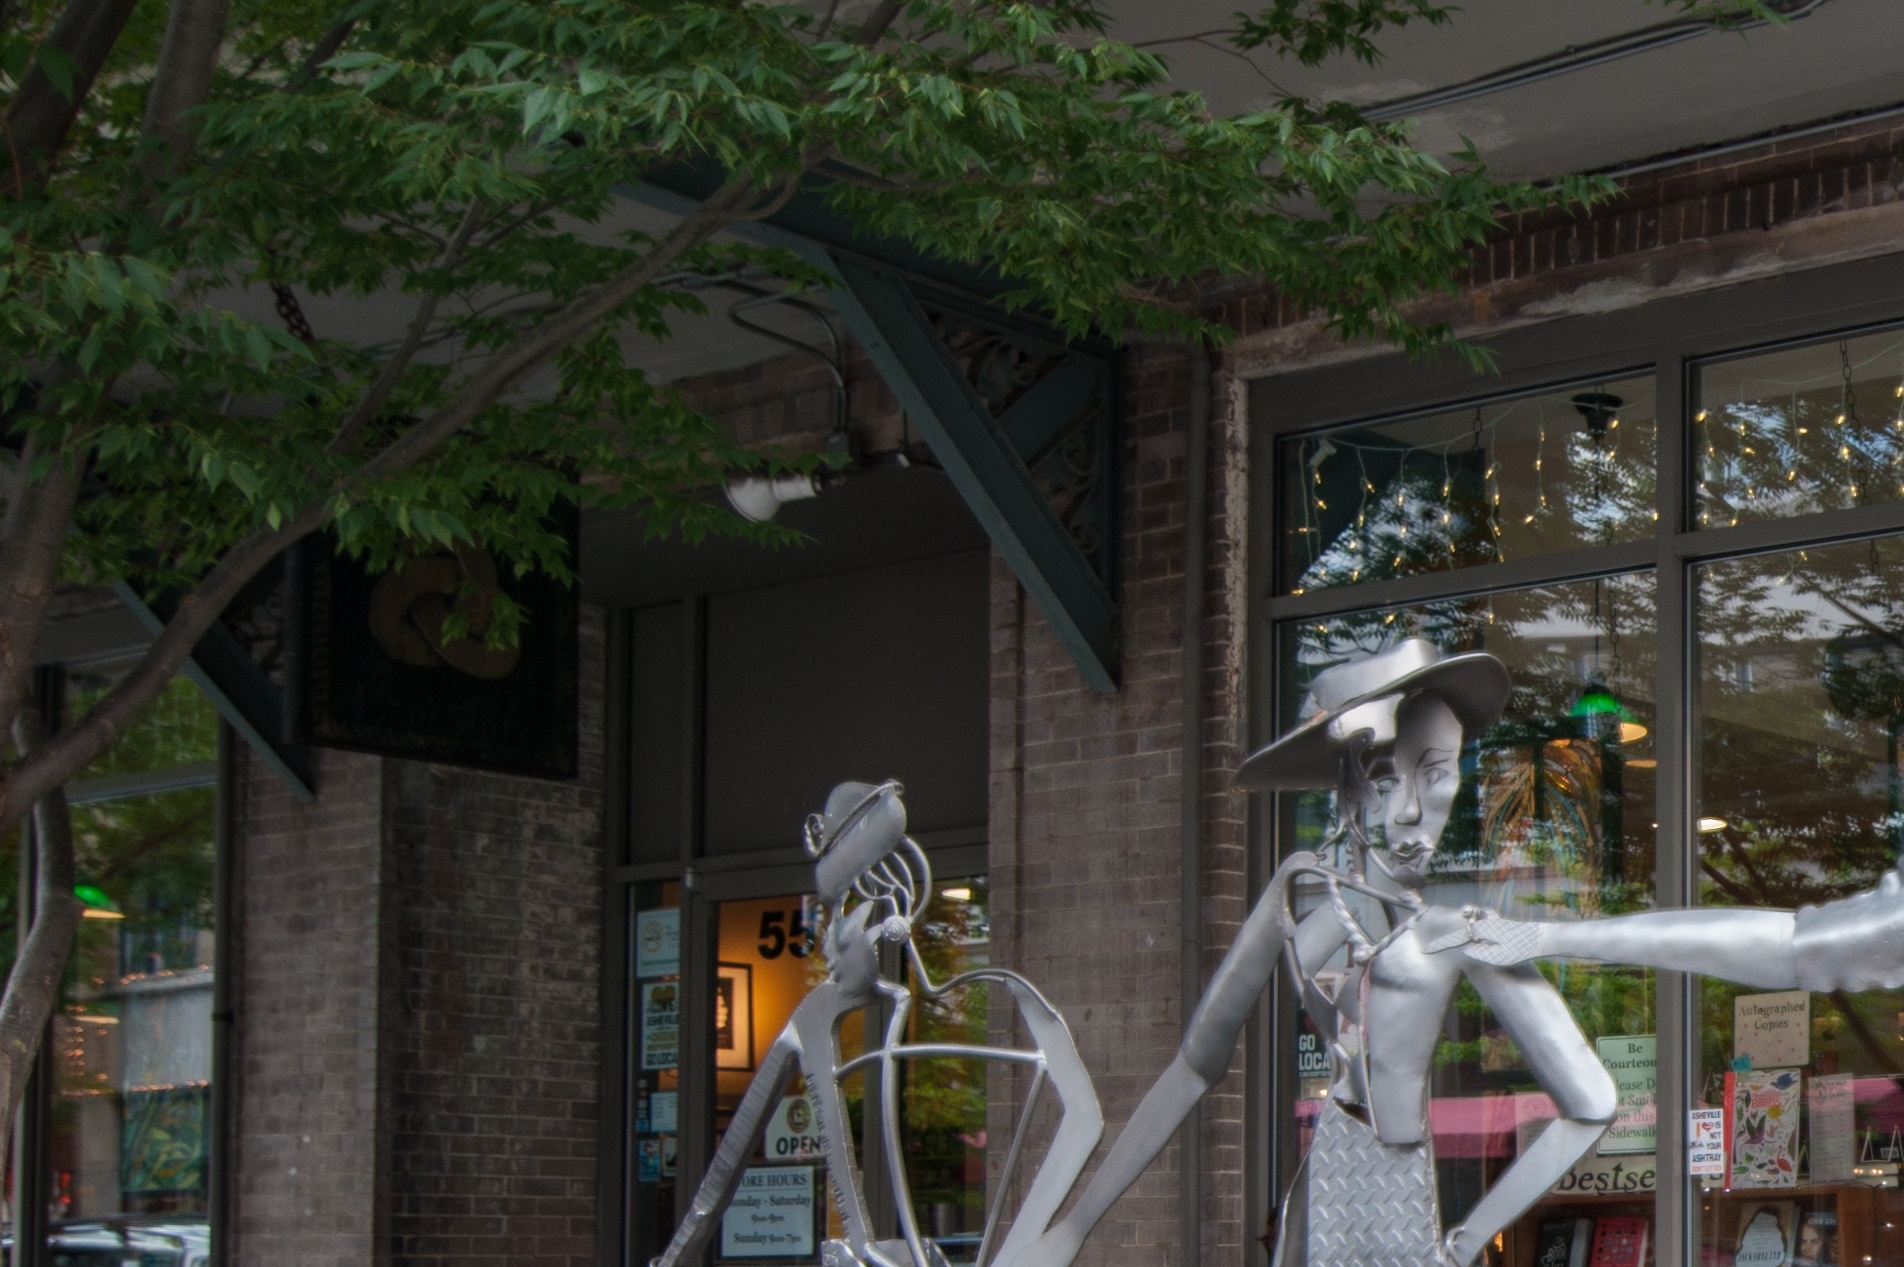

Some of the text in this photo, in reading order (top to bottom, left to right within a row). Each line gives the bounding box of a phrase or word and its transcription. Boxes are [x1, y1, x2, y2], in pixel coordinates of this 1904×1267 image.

[758, 910, 816, 960] 55
[1738, 1001, 1805, 1019] Autographed
[1754, 1018, 1788, 1032] Copies
[1628, 1043, 1643, 1054] Be
[1603, 1058, 1656, 1069] Courteou
[1617, 1110, 1654, 1122] on this
[1691, 1111, 1721, 1119] ASHEVILLE
[1709, 1131, 1721, 1139] NOT
[776, 1136, 821, 1156] OPEN
[1706, 1142, 1722, 1150] YOUR
[1692, 1154, 1722, 1163] ASHTRAY
[767, 1174, 807, 1186] HOURS
